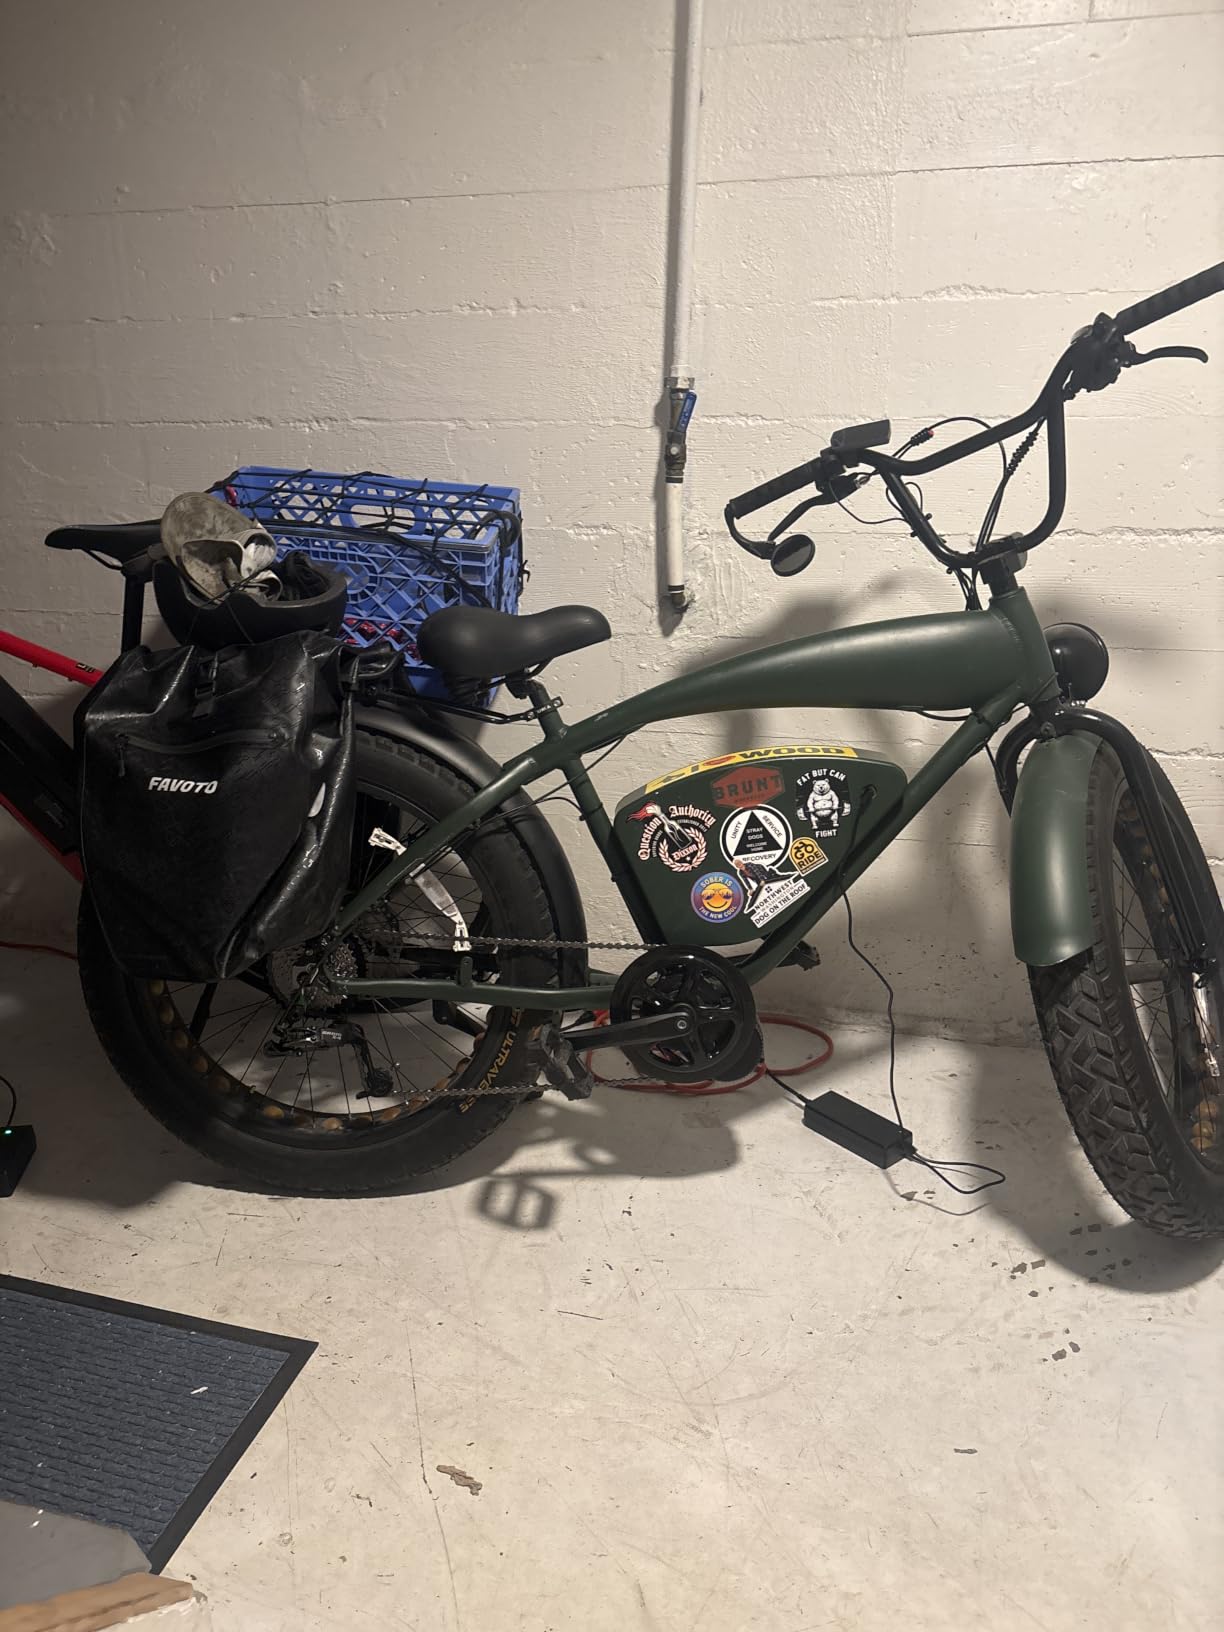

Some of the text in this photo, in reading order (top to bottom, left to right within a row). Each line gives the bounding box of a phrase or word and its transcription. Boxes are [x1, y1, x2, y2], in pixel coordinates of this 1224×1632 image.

[740, 747, 844, 759] WOOD
[148, 776, 219, 795] FAVOTO
[713, 775, 784, 799] BRUNT
[796, 768, 846, 787] FAT BUT CAN
[637, 817, 662, 861] Question
[668, 804, 717, 829] Authority
[730, 821, 744, 839] UNITY
[761, 815, 783, 839] SERVICE
[815, 829, 838, 839] FIGHT
[747, 833, 764, 841] DOGS
[742, 853, 777, 862] RECOVERY
[794, 843, 815, 861] GO
[797, 850, 822, 869] RIDE
[700, 876, 733, 888] SOBER IS
[754, 880, 794, 911] NORTHWEST
[755, 883, 807, 925] DOG ON THE ROOF
[760, 886, 795, 913] WASHINGTON
[698, 906, 710, 917] THE
[723, 905, 738, 918] COOL
